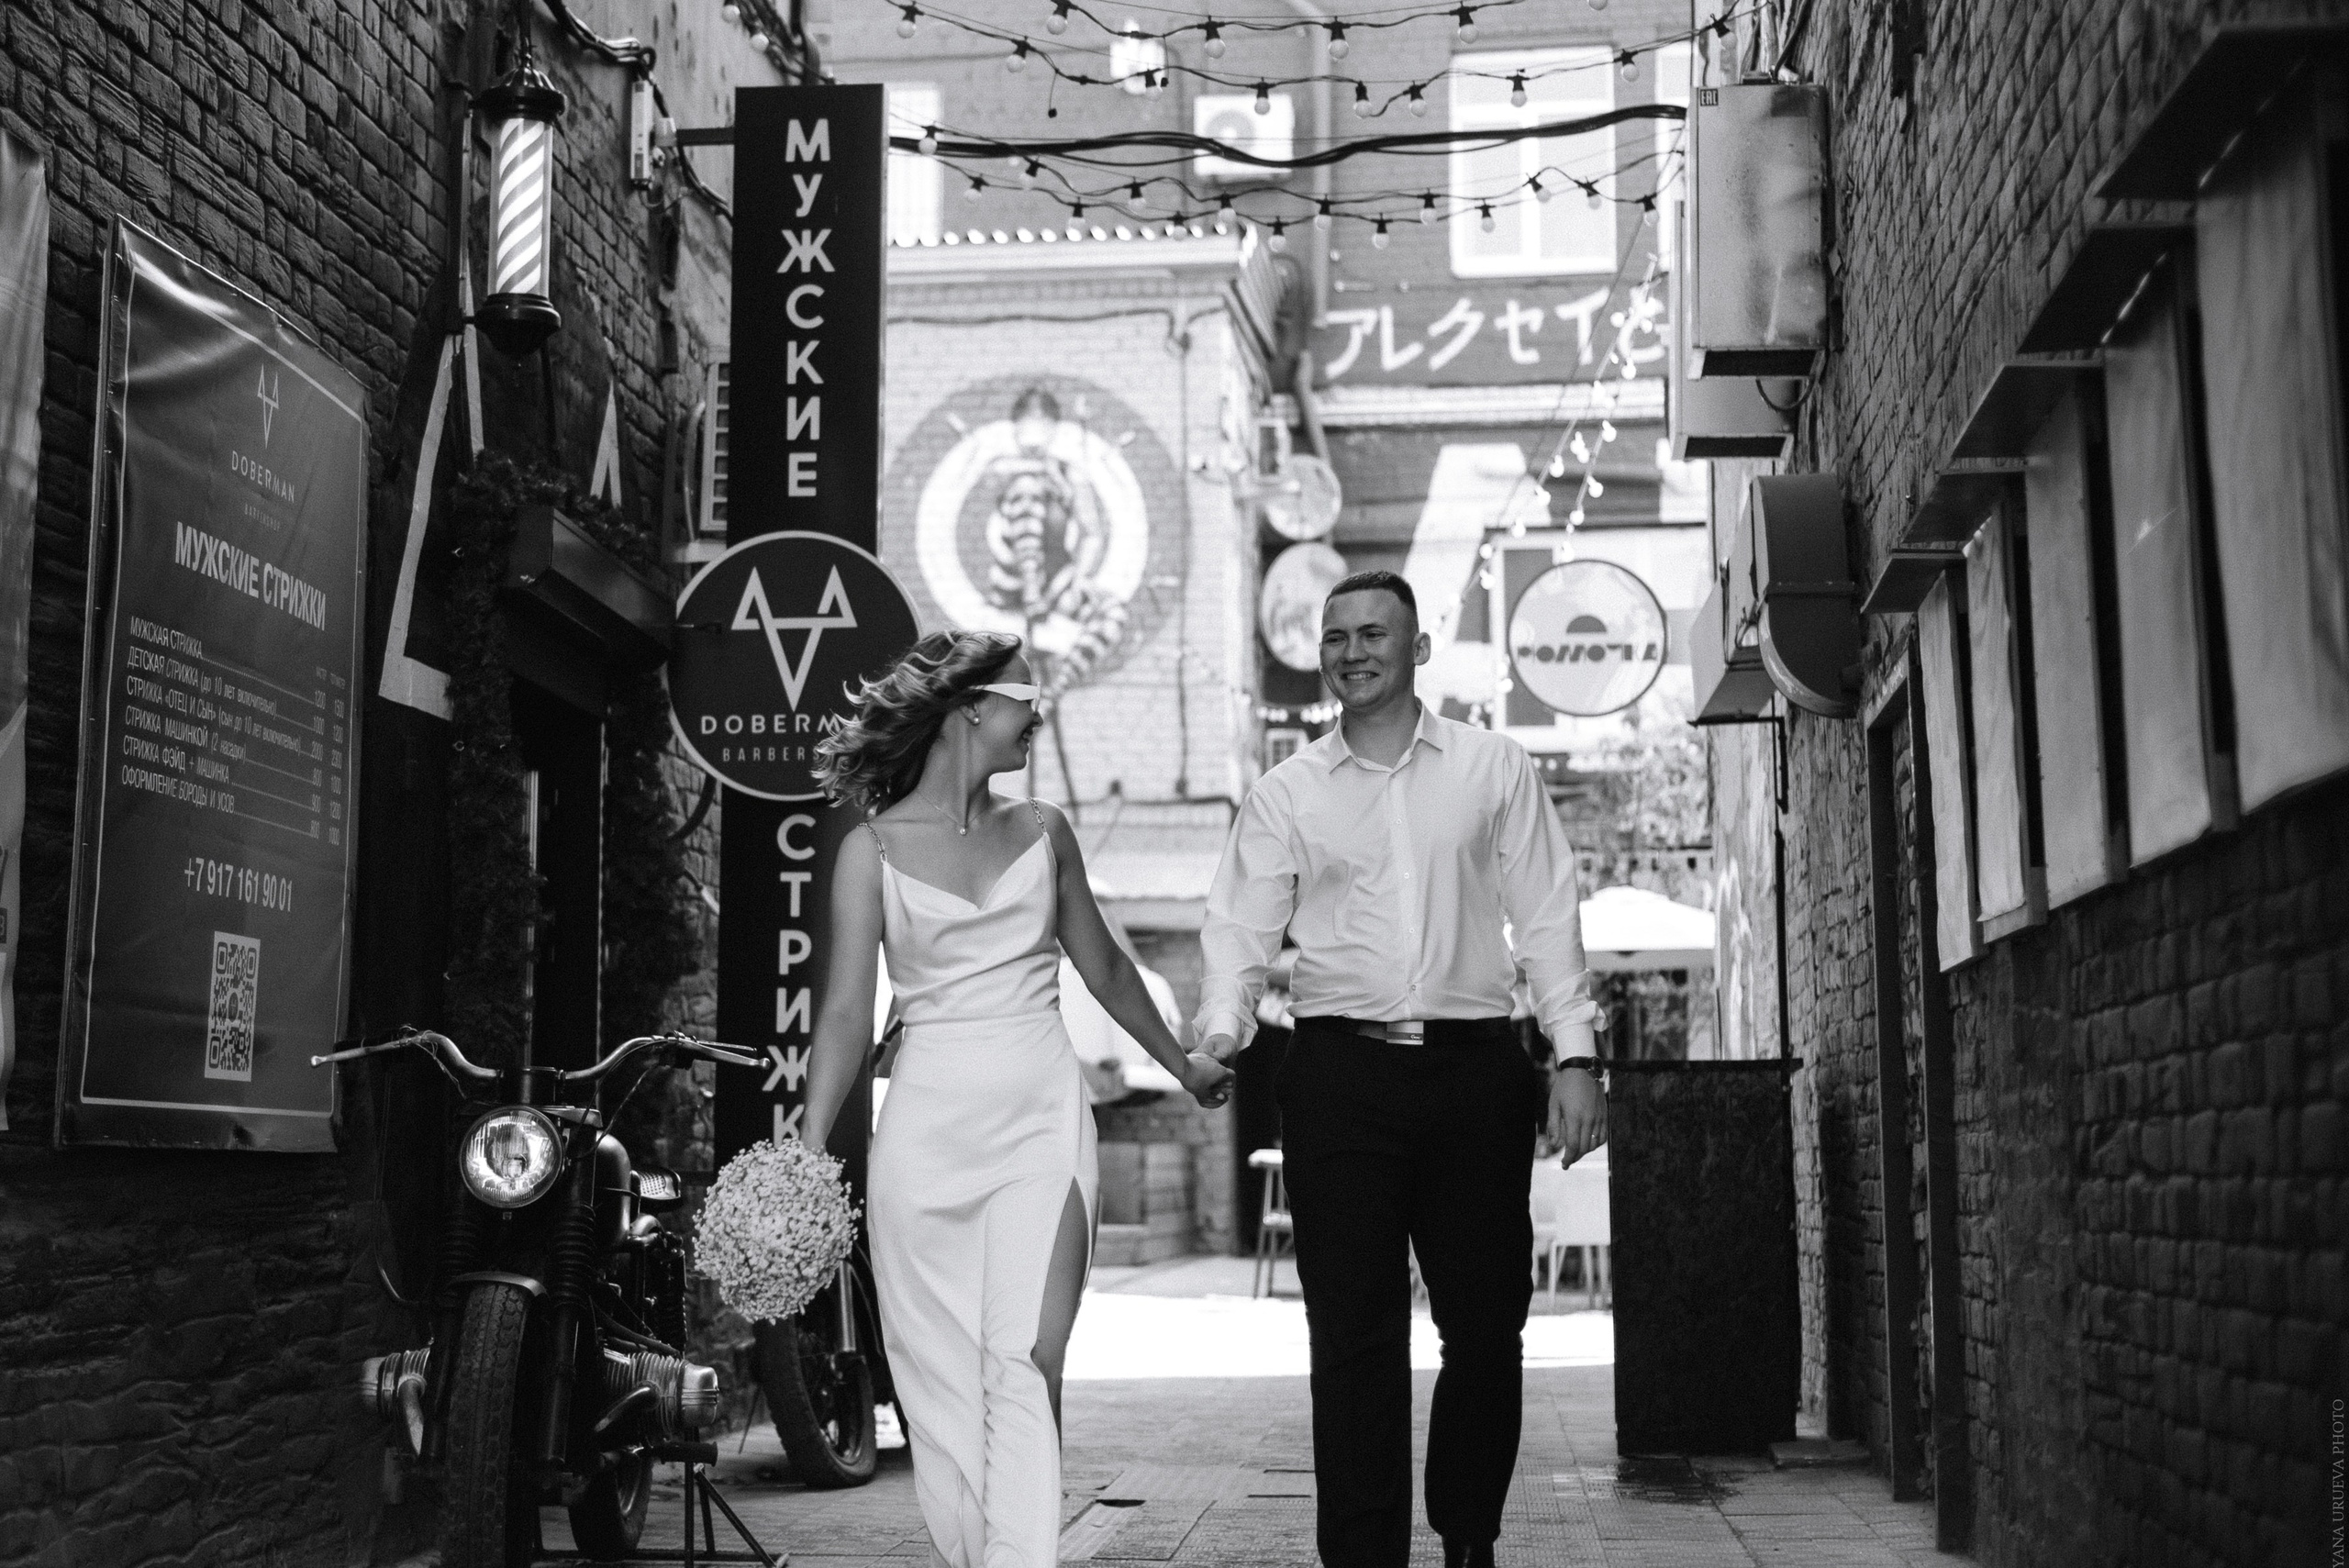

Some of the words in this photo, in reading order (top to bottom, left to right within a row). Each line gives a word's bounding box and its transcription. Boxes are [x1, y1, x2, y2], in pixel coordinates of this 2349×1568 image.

[776, 117, 836, 498] МУЖСКИЕ
[231, 450, 295, 504] DOBERMAN
[175, 521, 260, 598] МУЖСКИЕ
[263, 562, 327, 631] СТРИЖКИ
[130, 616, 169, 648] МУЖСКАЯ
[171, 629, 203, 660] СТРИЖКА
[128, 646, 165, 674] ДЕТСКАЯ
[166, 659, 198, 687] СТРИЖКА
[201, 672, 212, 695] (до
[215, 676, 222, 695] 10
[224, 684, 235, 700] лет
[125, 705, 161, 734] СТРИЖКА
[165, 717, 208, 748] МАШИНКОЙ
[211, 731, 218, 754] (2
[127, 675, 162, 705] СТРИЖКА
[190, 696, 195, 714] И
[218, 706, 233, 728] (сын
[234, 717, 242, 733] до
[245, 716, 252, 734] 10
[701, 714, 861, 735] DOBERM
[123, 735, 160, 763] СТРИЖКА
[162, 746, 186, 774] ФЭЙД
[196, 757, 229, 784] МАШИНКА
[723, 746, 820, 762] BARBERS
[121, 764, 178, 797] ОФОРМЛЕНИЕ
[179, 781, 208, 808] БОРОДЫ
[210, 789, 216, 808] И
[217, 793, 235, 814] УСОВ
[184, 857, 205, 892] +7
[207, 859, 234, 898] 917
[238, 867, 260, 904] 161
[262, 873, 277, 908] 90
[278, 877, 293, 912] 01
[762, 813, 816, 1150] СТРИЖК
